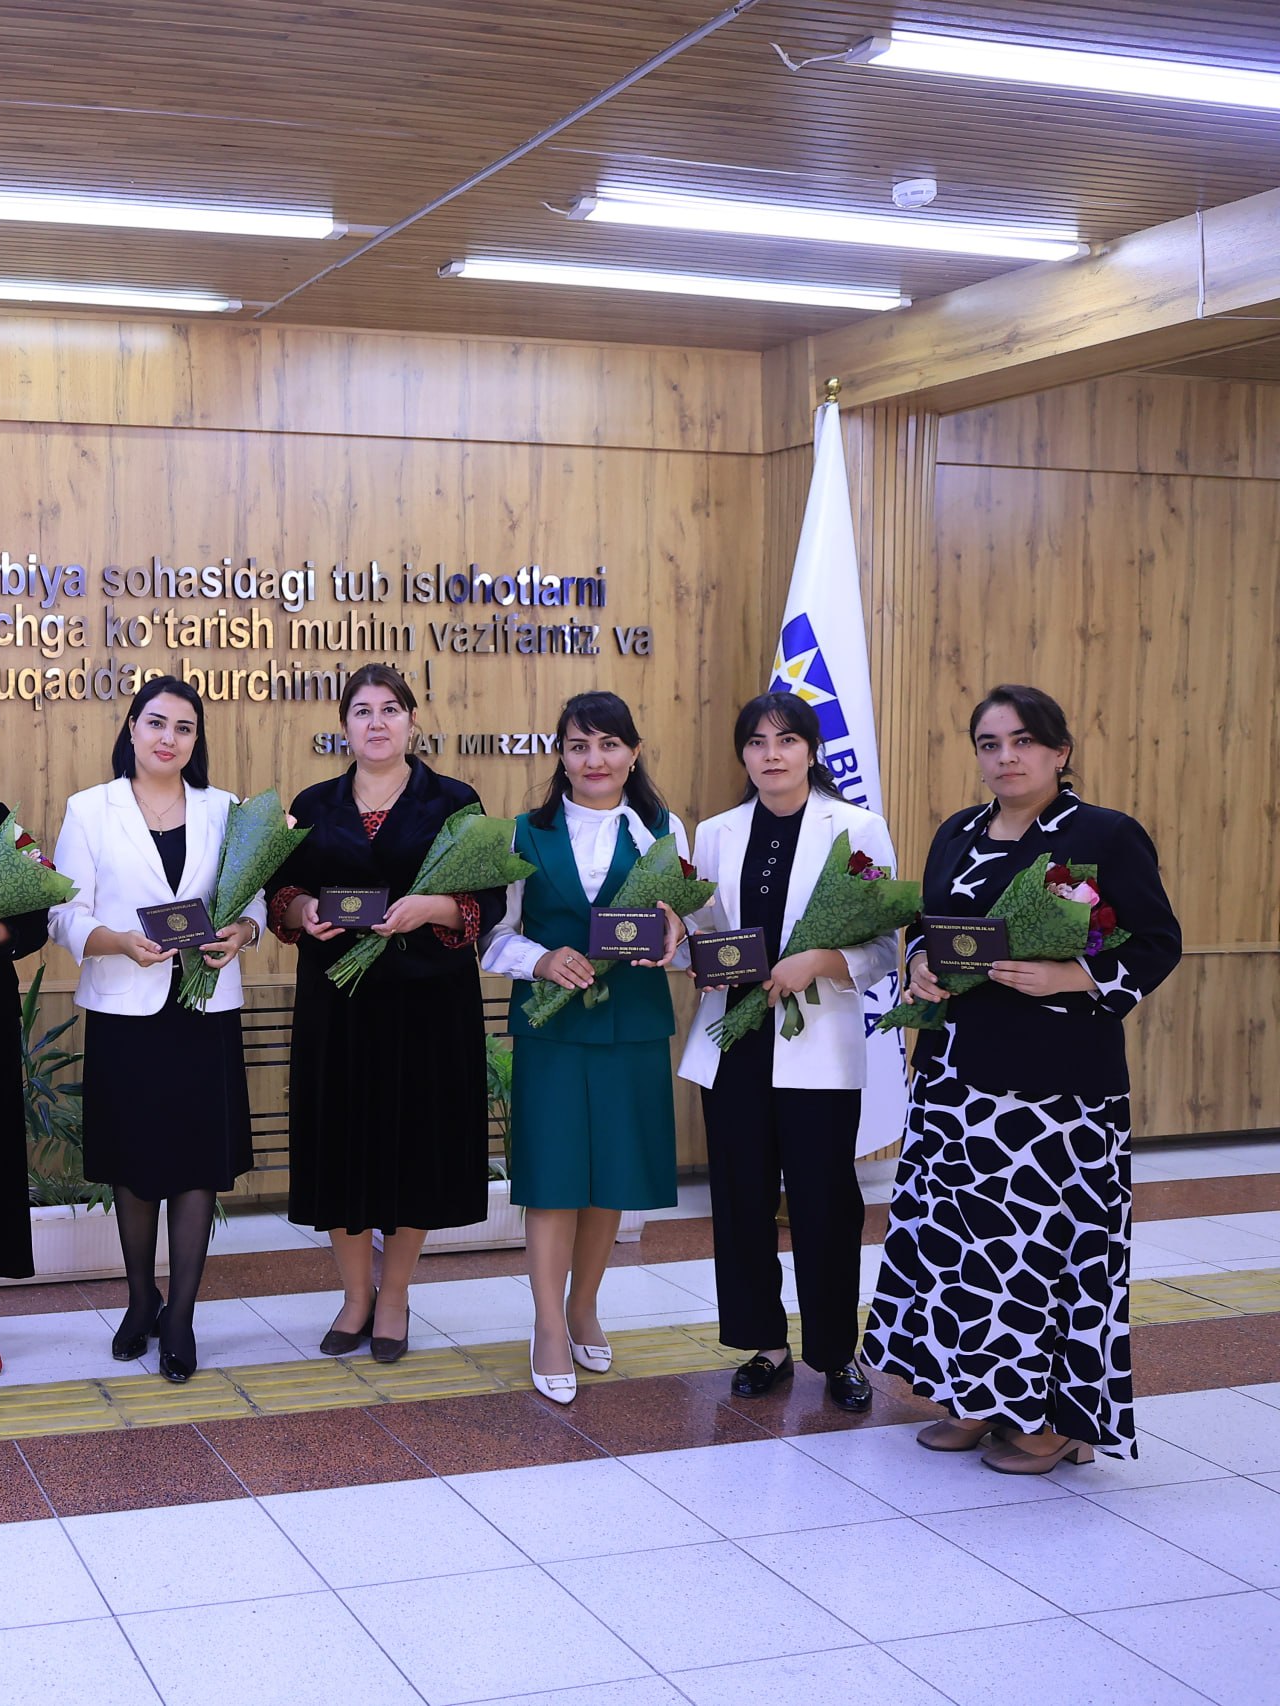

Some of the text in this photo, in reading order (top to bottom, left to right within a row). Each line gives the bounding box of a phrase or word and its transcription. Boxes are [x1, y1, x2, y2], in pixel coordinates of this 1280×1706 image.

[103, 556, 316, 612] sohasidagi
[332, 560, 391, 603] tub
[402, 562, 608, 607] islohotlarni
[290, 609, 417, 652] muhim
[431, 612, 601, 656] vazifamiz
[613, 622, 655, 656] va
[181, 657, 418, 701] burchimi
[314, 732, 562, 755] SHAT MIRZIY
[824, 747, 870, 811] BU
